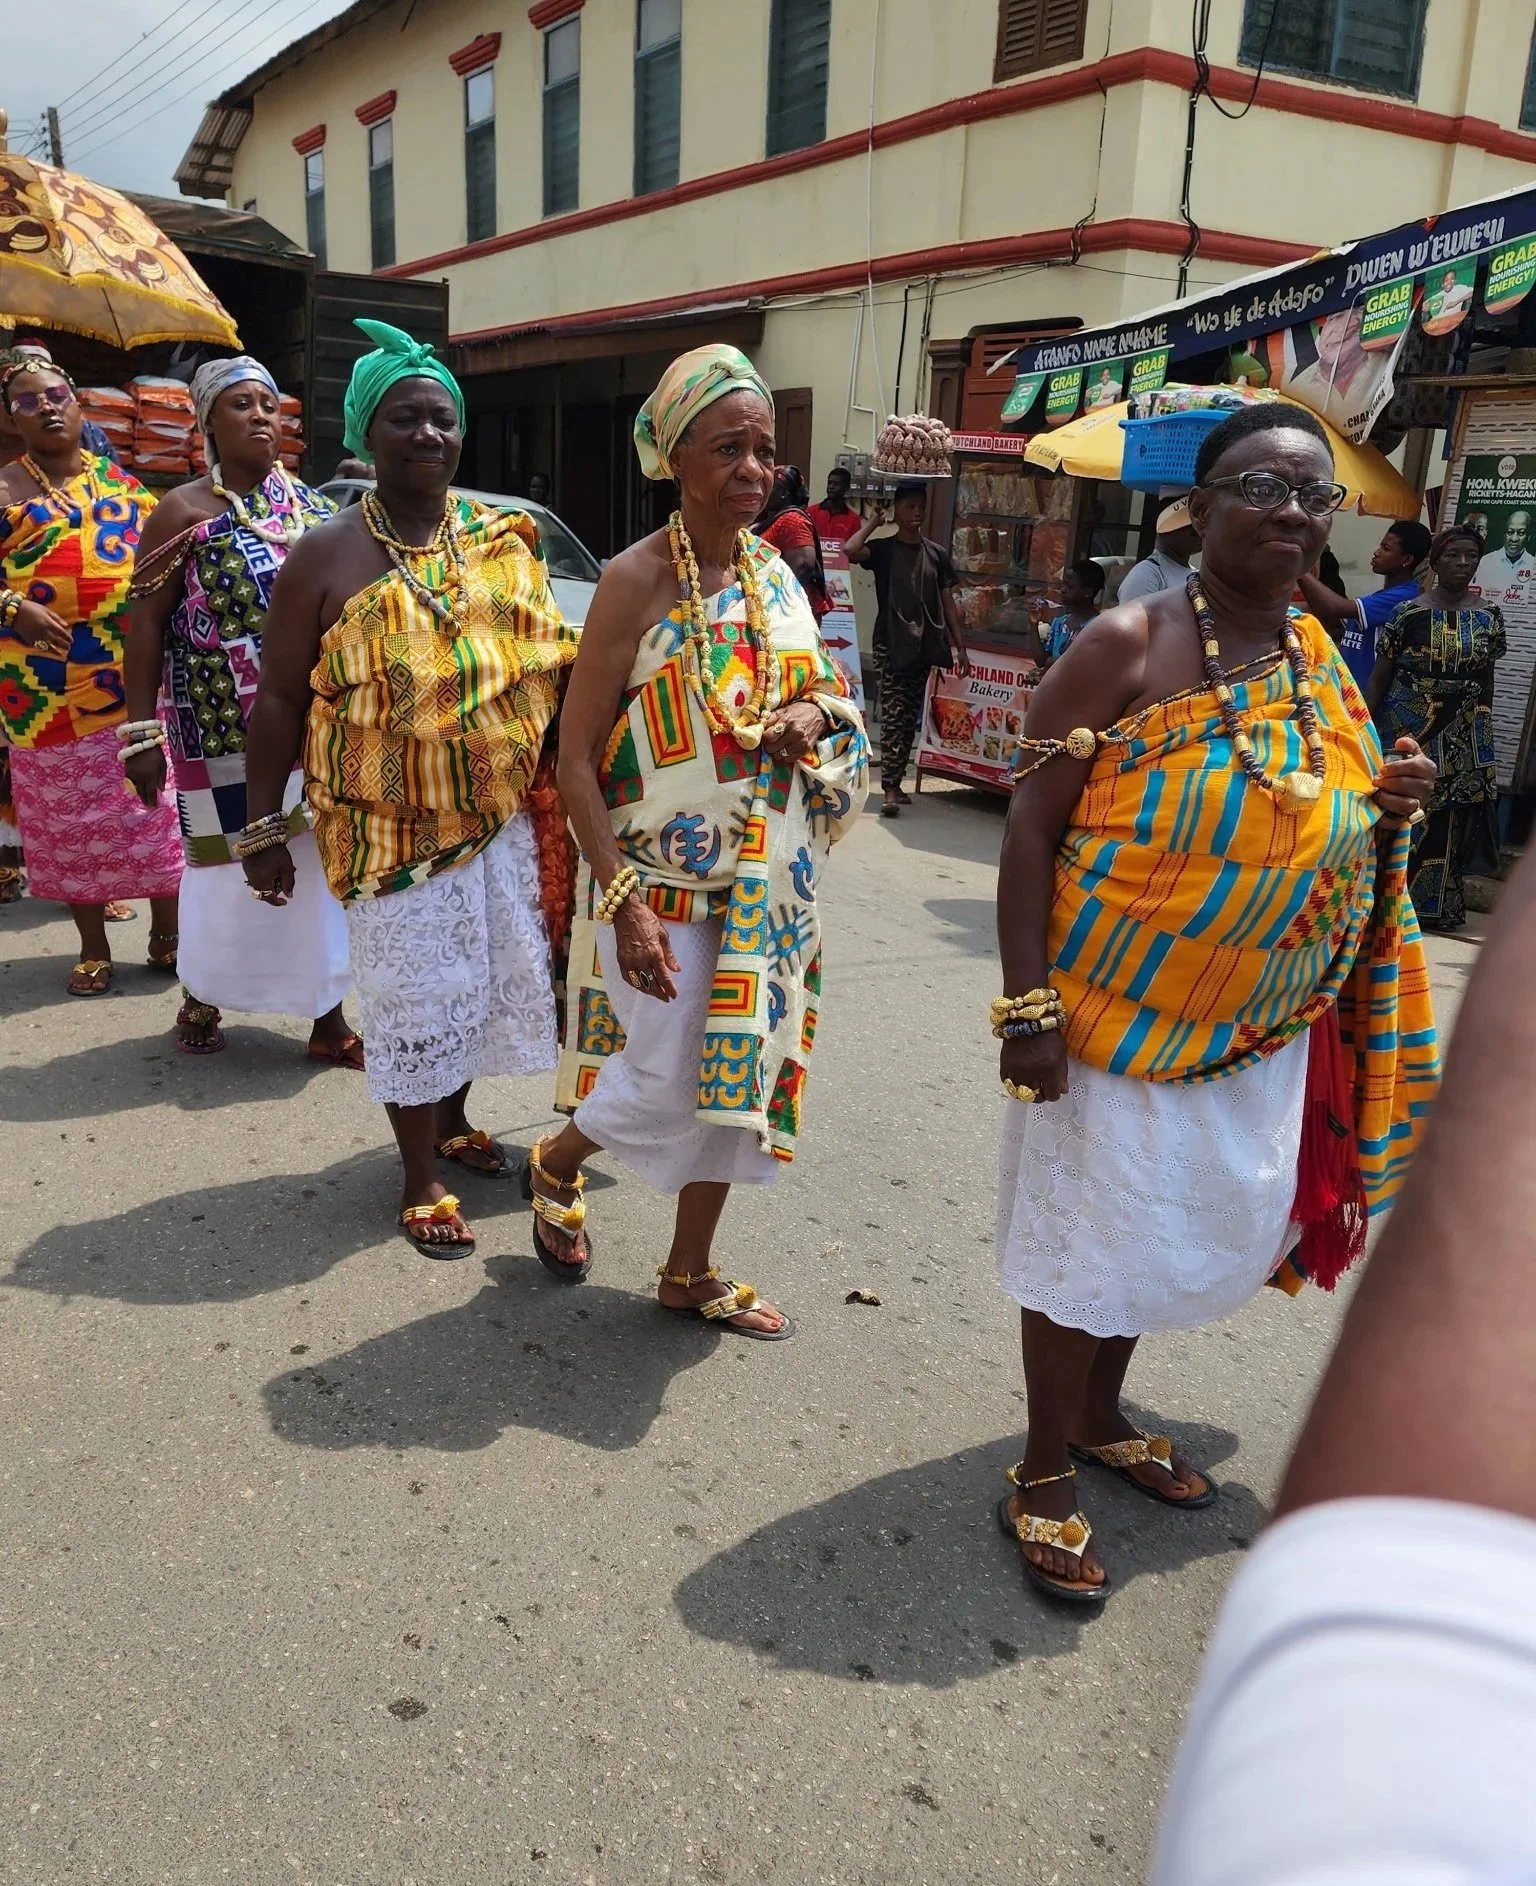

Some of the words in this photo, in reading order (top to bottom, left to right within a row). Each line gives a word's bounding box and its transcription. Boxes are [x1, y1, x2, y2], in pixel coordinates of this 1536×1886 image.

[1491, 241, 1536, 274] GRAB
[1341, 248, 1404, 298] DWEN
[1489, 258, 1536, 284] NOURISHING
[1487, 267, 1535, 297] ENERGY!
[1366, 283, 1411, 312] GRAB
[1362, 310, 1408, 334] ENERGY!
[1364, 302, 1409, 322] NOURISHING
[1132, 354, 1166, 376] GRAB
[1050, 372, 1080, 392] GRAB
[1047, 394, 1078, 409] ENERGY!
[994, 438, 1024, 451] BAKERY
[1501, 463, 1515, 471] vote
[1466, 478, 1495, 489] HON.
[1496, 478, 1536, 489] KWEK
[1468, 490, 1536, 498] RICKETTS-HAGAN
[1518, 569, 1531, 578] #8
[969, 681, 1013, 703] Bakery
